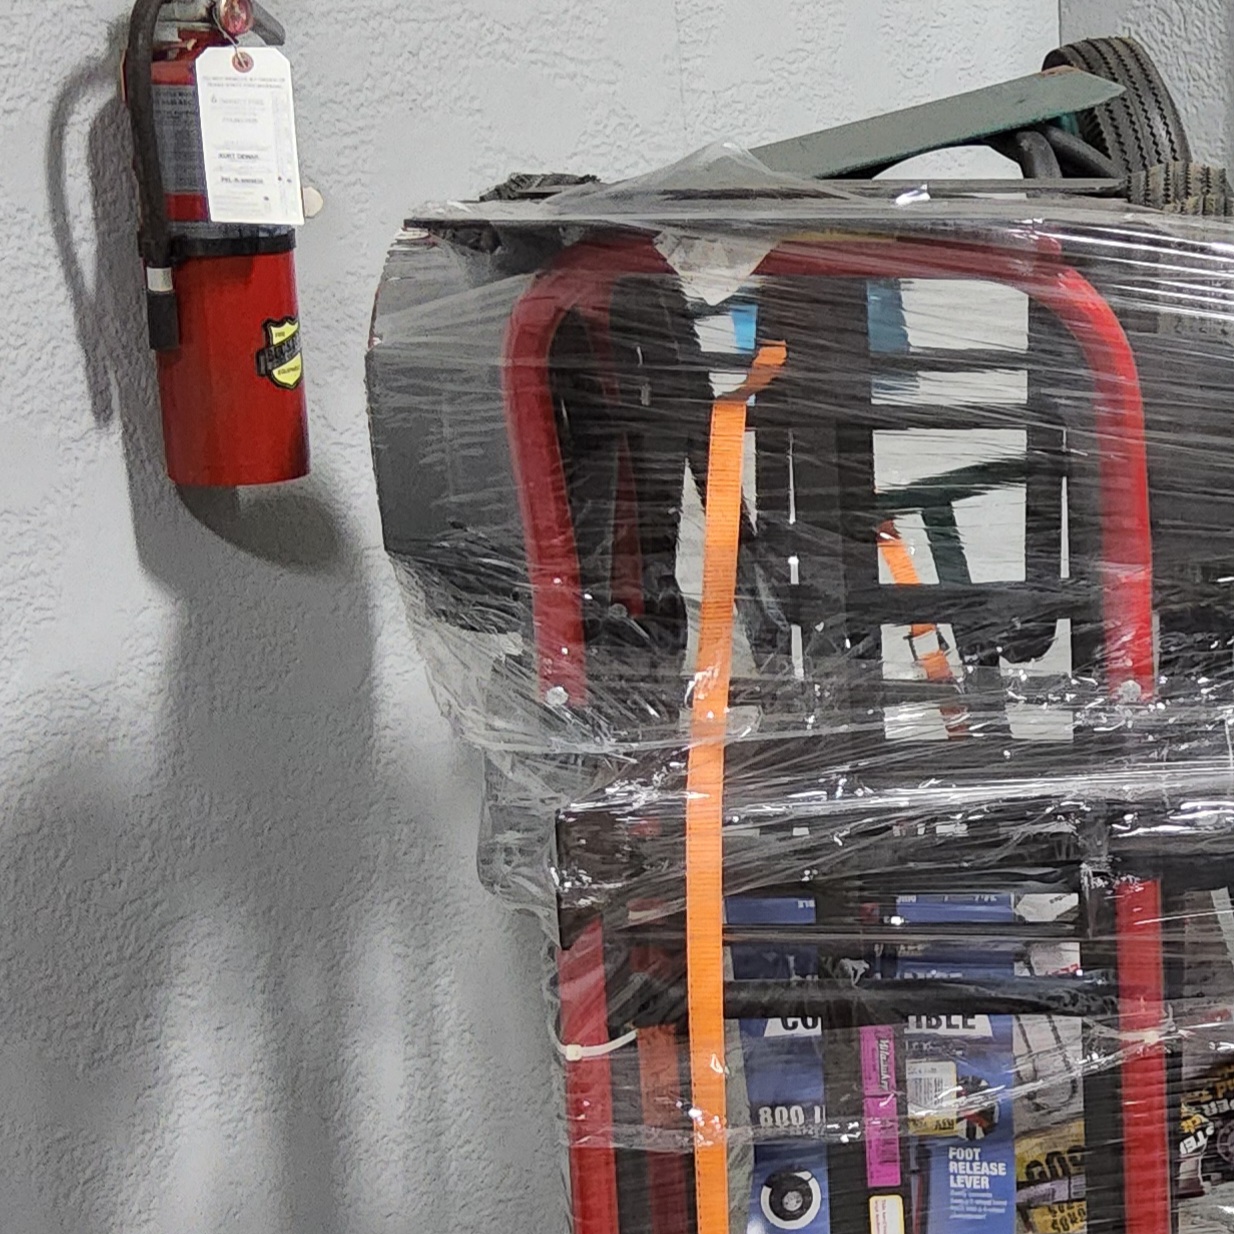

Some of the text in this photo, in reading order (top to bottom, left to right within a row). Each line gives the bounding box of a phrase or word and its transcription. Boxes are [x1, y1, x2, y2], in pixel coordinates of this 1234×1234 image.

[758, 1106, 804, 1125] 800
[949, 1148, 981, 1161] FOOT
[949, 1162, 1007, 1176] RELEASE
[951, 1176, 990, 1189] LEVER
